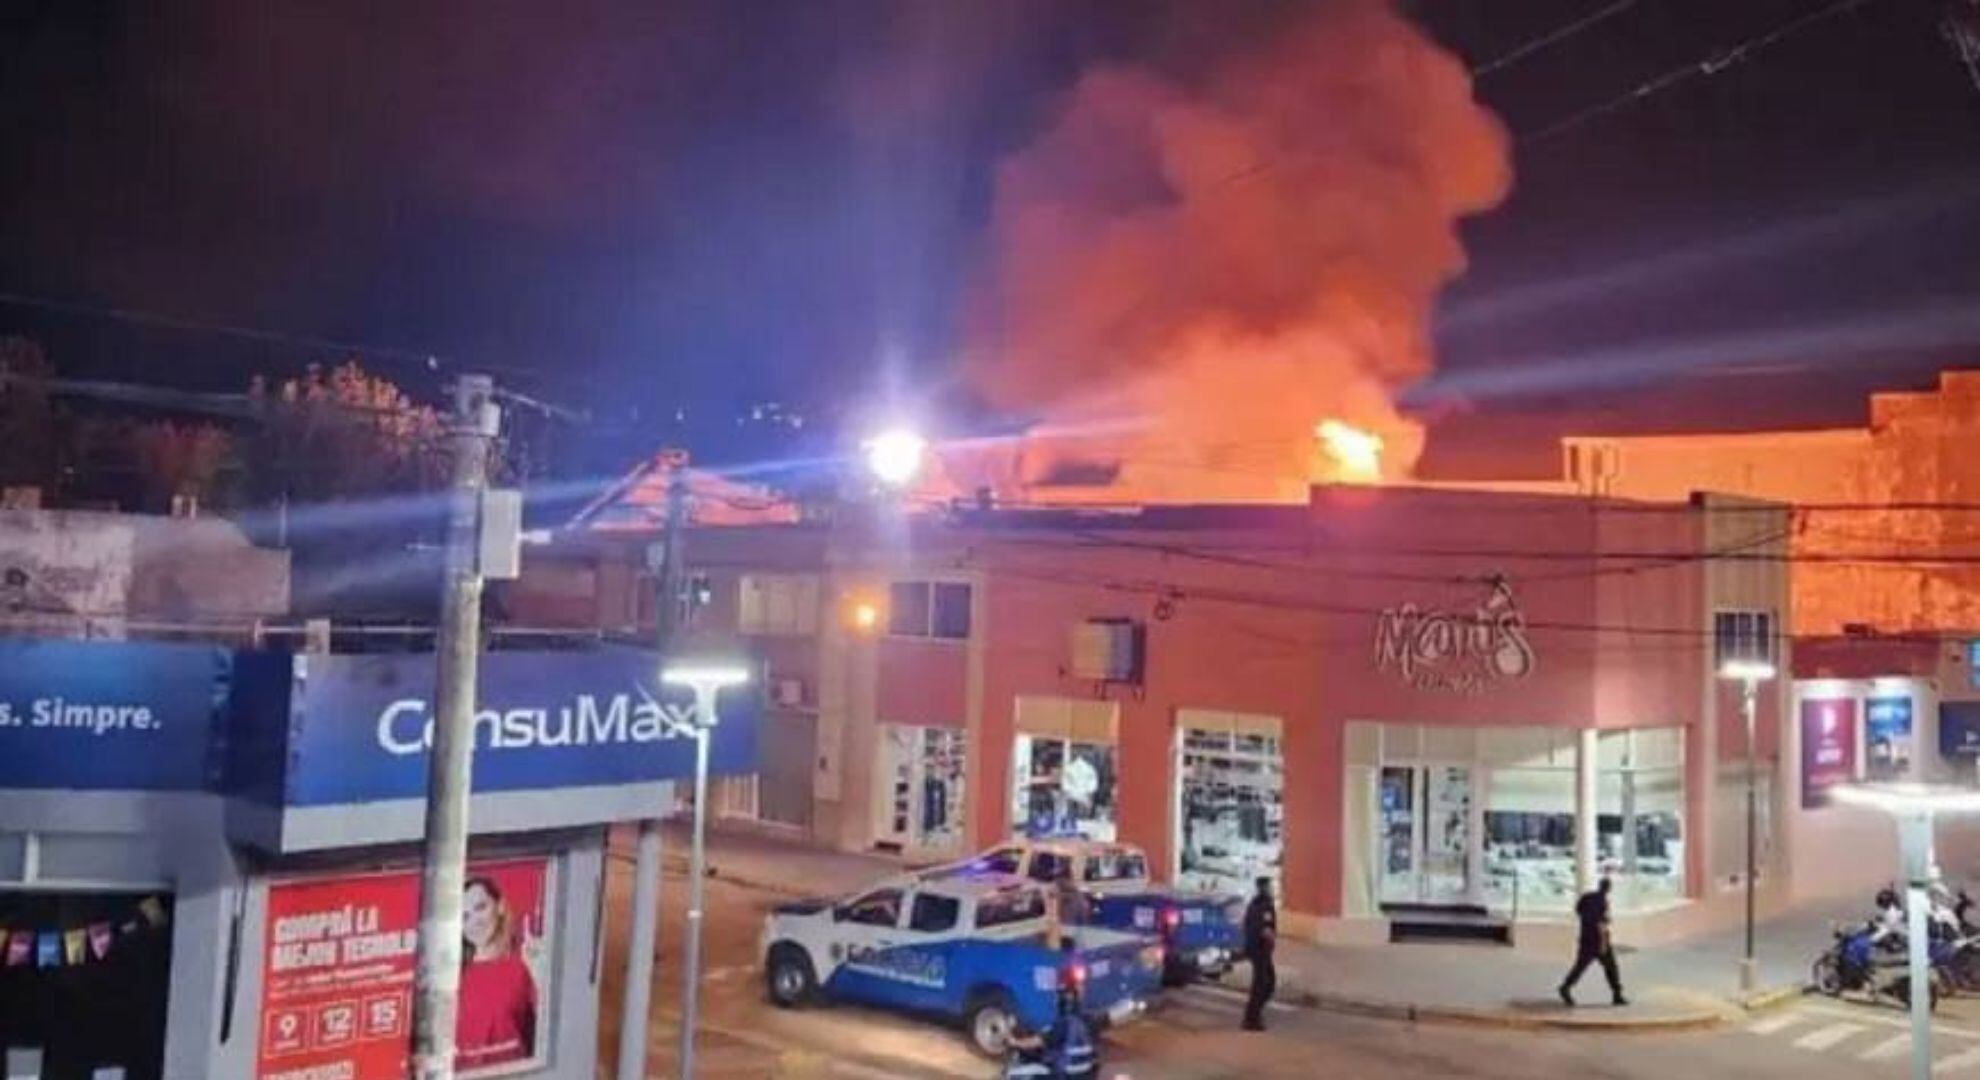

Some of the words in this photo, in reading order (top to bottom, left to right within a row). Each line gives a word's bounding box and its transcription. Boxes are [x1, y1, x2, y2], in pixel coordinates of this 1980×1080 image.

[32, 697, 161, 735] Simpre.
[279, 1013, 297, 1038] 9
[322, 1006, 351, 1032] 12
[370, 1000, 397, 1026] 15
